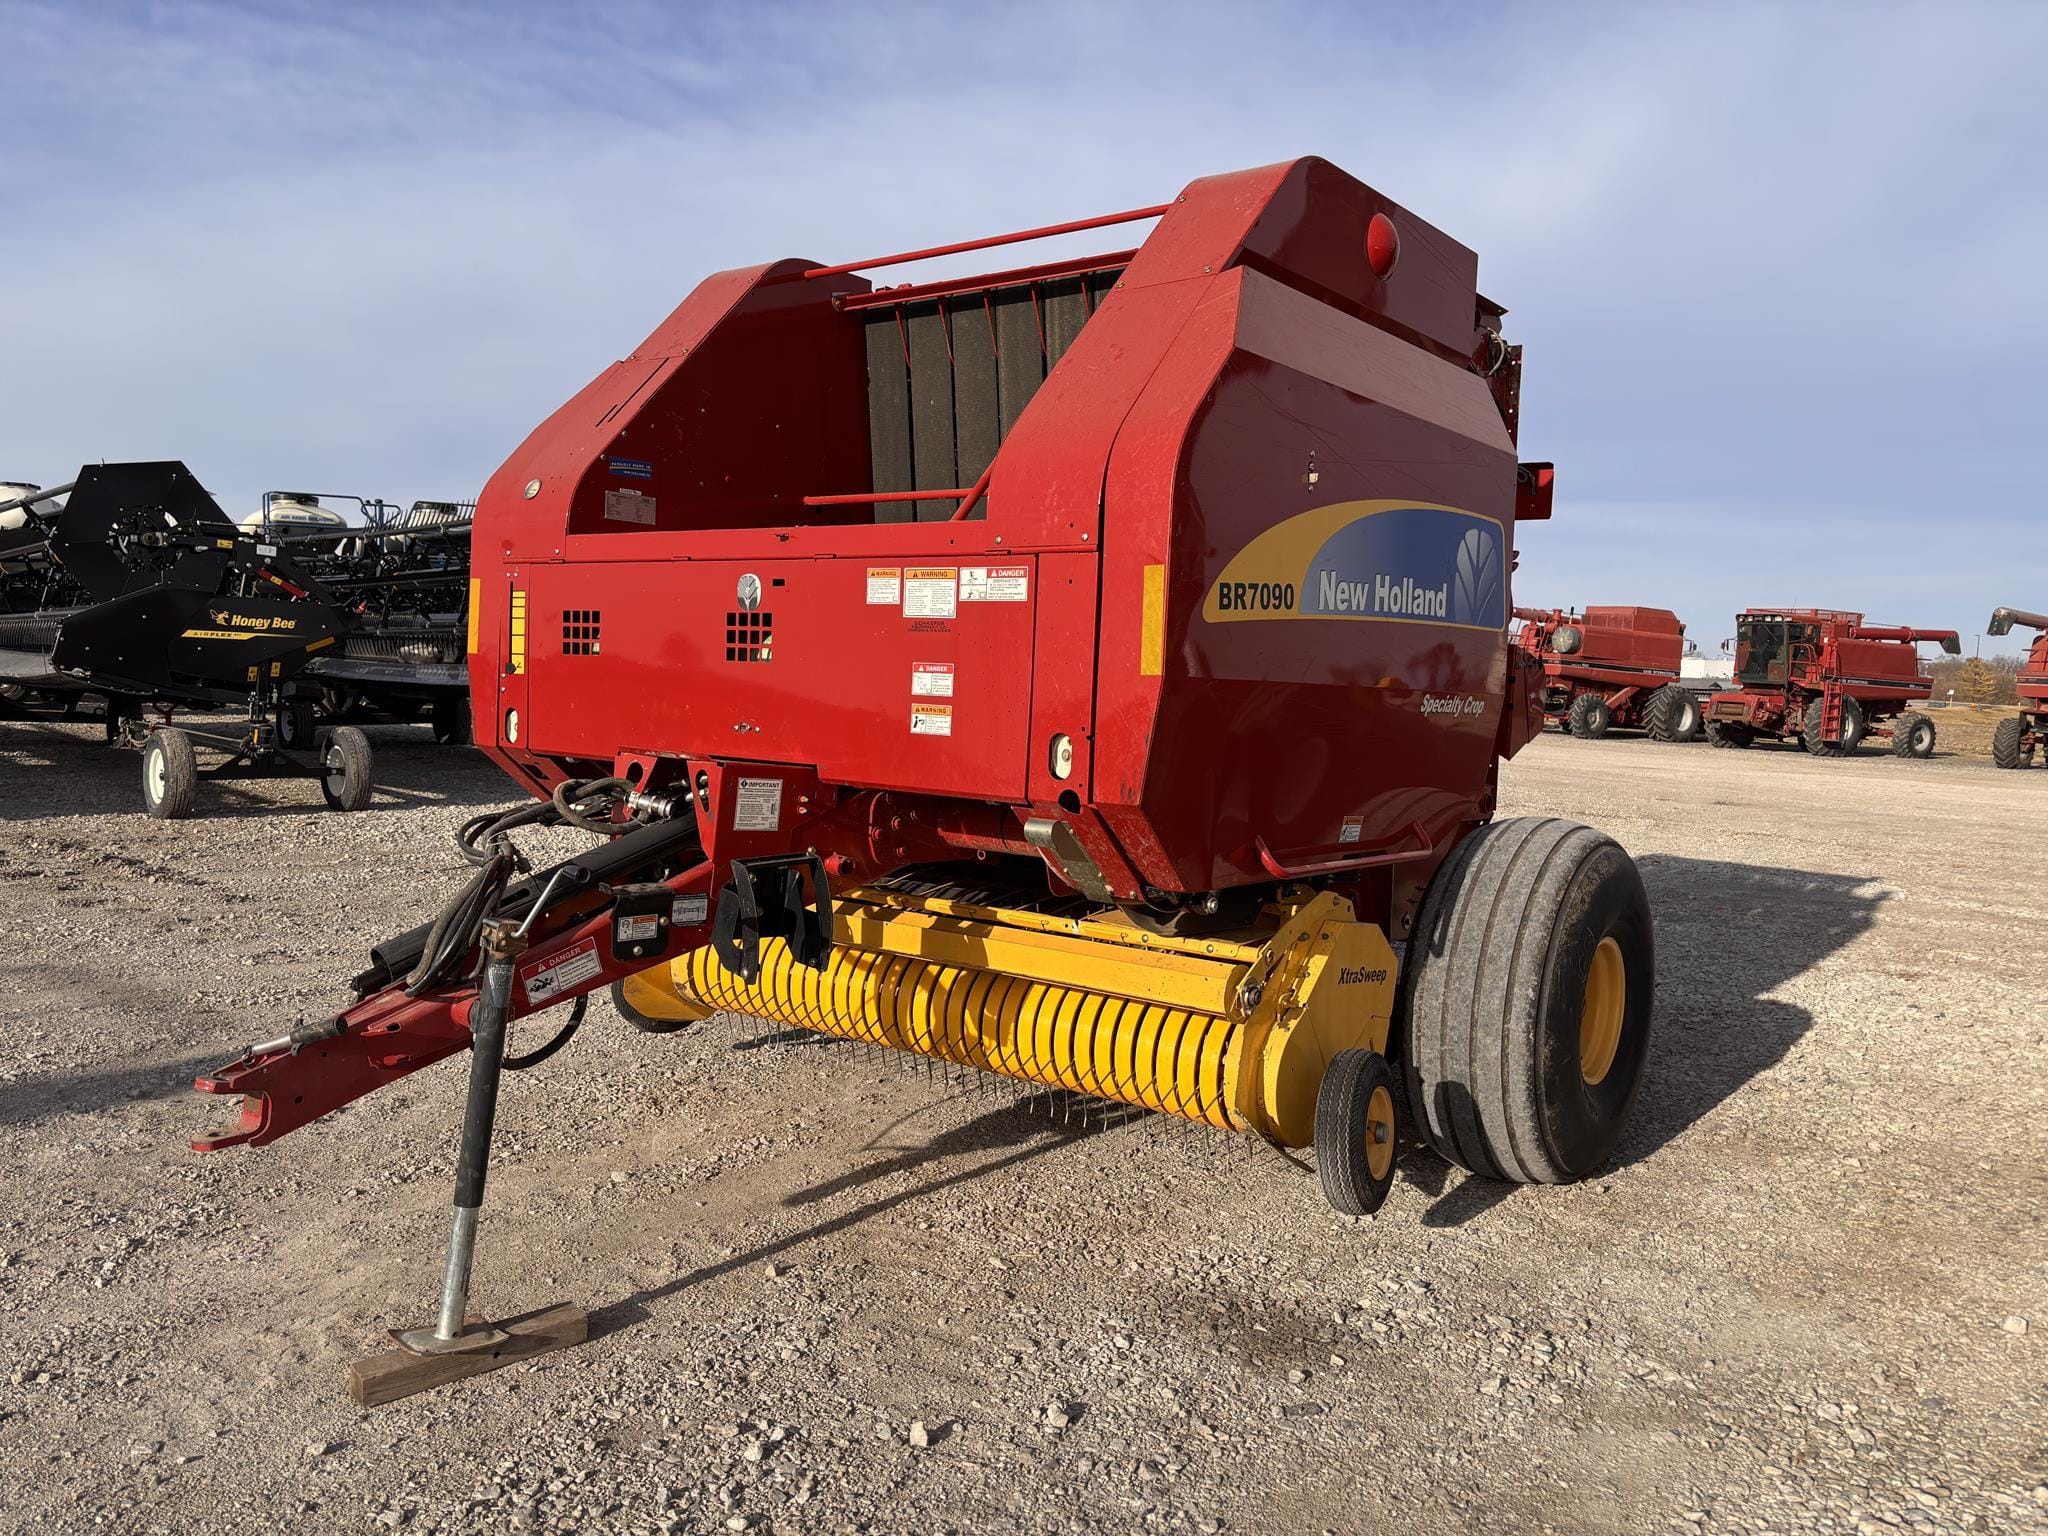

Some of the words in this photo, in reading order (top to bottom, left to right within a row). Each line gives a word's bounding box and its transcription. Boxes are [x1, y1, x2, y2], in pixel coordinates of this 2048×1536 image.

[1219, 582, 1294, 611] BR7090
[1318, 570, 1368, 611] New
[1373, 574, 1447, 618] Holland
[231, 615, 270, 629] Honey
[272, 617, 296, 629] Bee
[1420, 693, 1464, 718] Specialty
[1464, 696, 1485, 719] Crop
[549, 947, 582, 967] DANGER
[1338, 966, 1387, 986] XtraSweep
